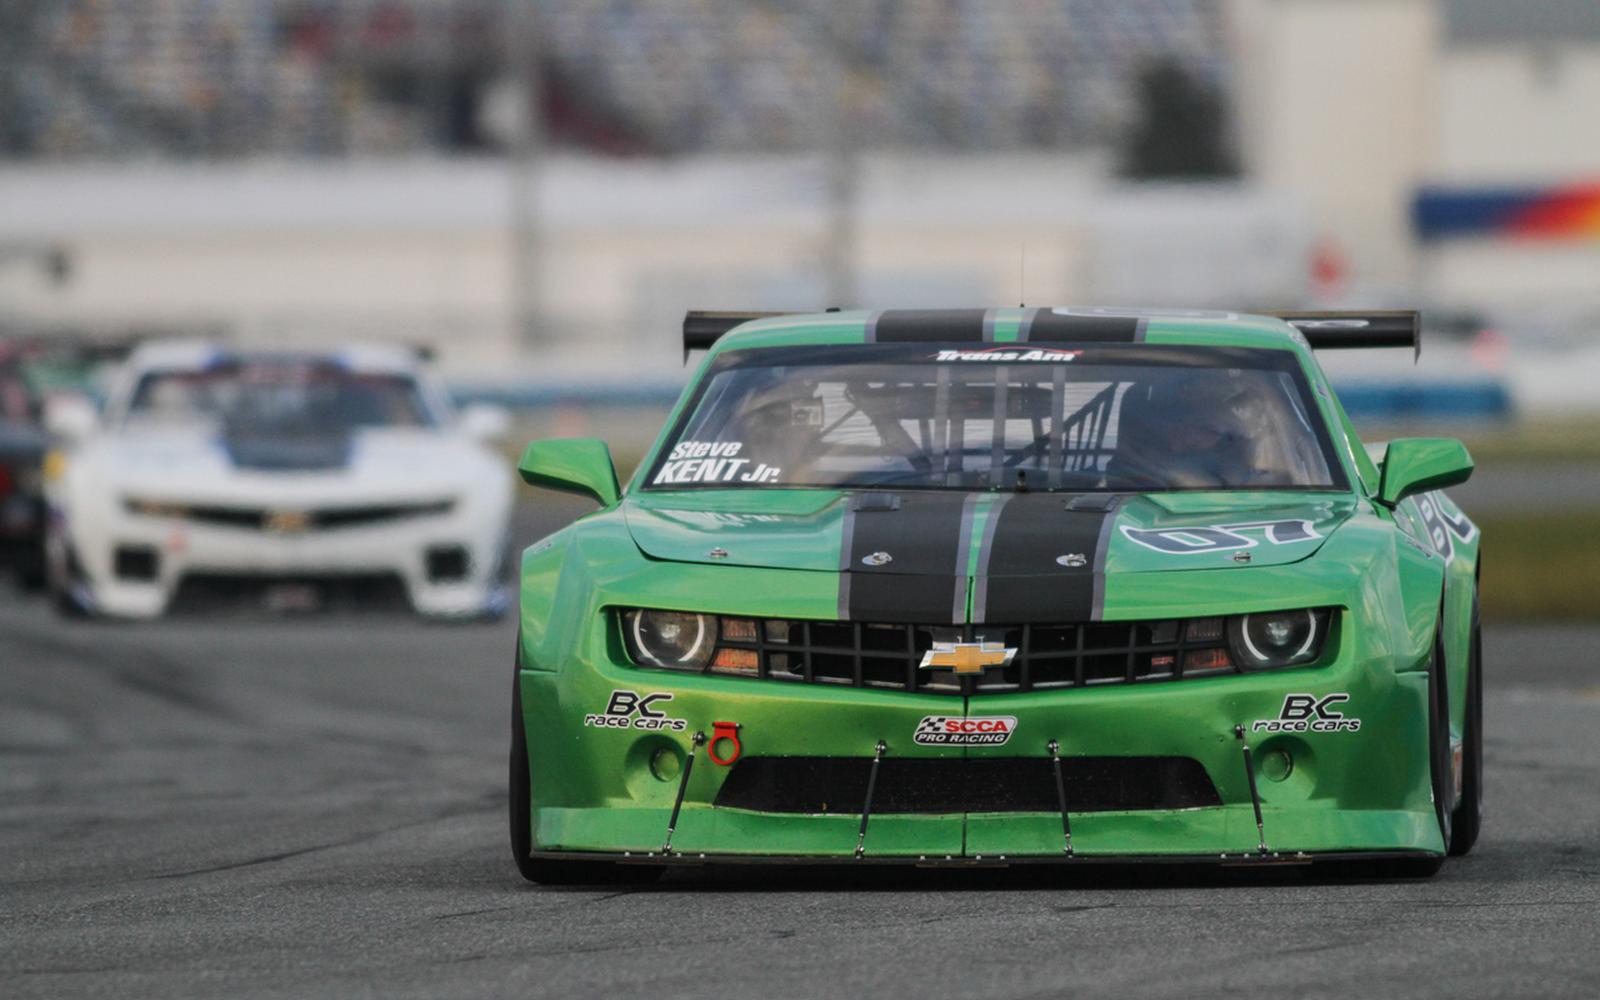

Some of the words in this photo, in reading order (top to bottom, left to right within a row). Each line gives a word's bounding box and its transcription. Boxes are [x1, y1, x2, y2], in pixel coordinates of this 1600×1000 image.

[668, 441, 743, 460] Steve
[652, 458, 750, 484] KENT
[741, 463, 781, 483] Jr.
[1120, 519, 1323, 554] 07
[606, 690, 673, 719] BC
[1279, 694, 1349, 720] BC
[584, 714, 630, 728] race
[633, 717, 687, 731] cars
[945, 720, 1008, 733] SCCA
[1252, 719, 1308, 732] race
[1311, 719, 1361, 731] cars
[917, 734, 946, 743] PRO
[950, 734, 1006, 743] RACING
